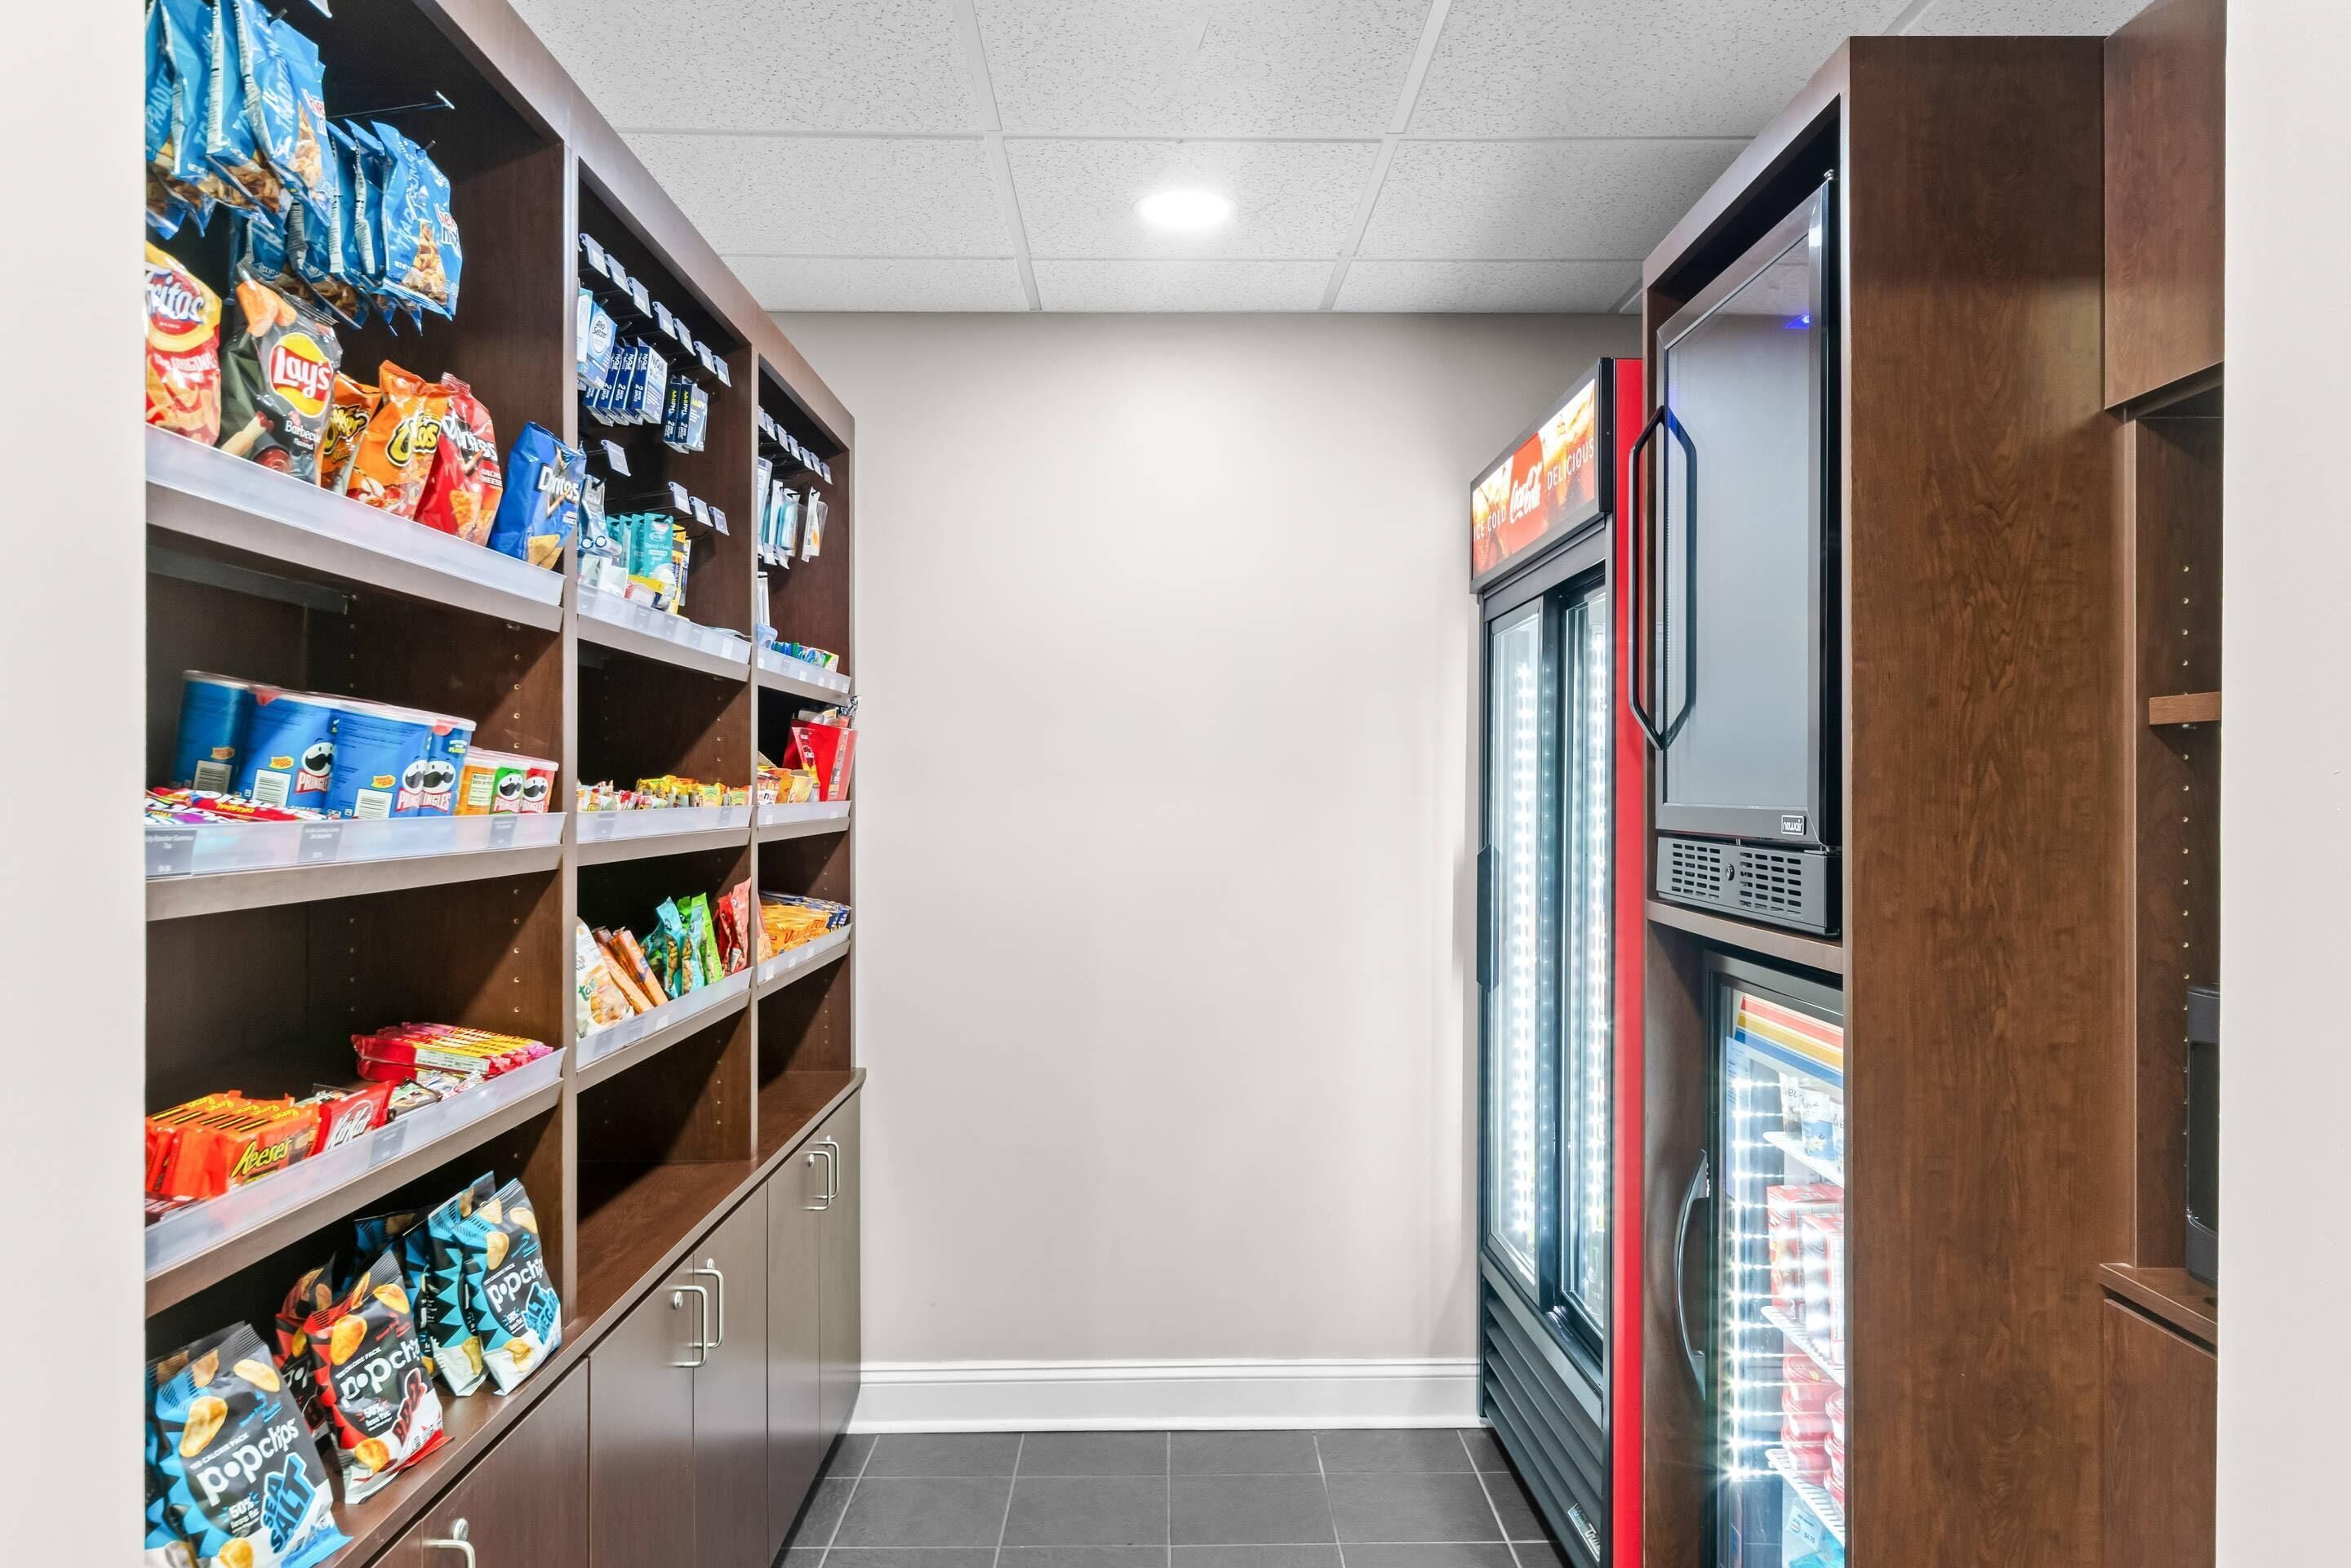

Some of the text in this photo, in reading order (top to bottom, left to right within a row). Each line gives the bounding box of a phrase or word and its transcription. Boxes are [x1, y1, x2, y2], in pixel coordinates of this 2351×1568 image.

[273, 347, 331, 398] Lay's
[1547, 437, 1594, 491] DELICIOUS
[1473, 505, 1506, 542] ICE COLD
[1783, 819, 1802, 832] newair
[196, 1417, 300, 1507] popchips
[229, 1495, 256, 1519] 50%
[263, 1476, 283, 1530] SEA
[270, 1458, 312, 1554] SALT
